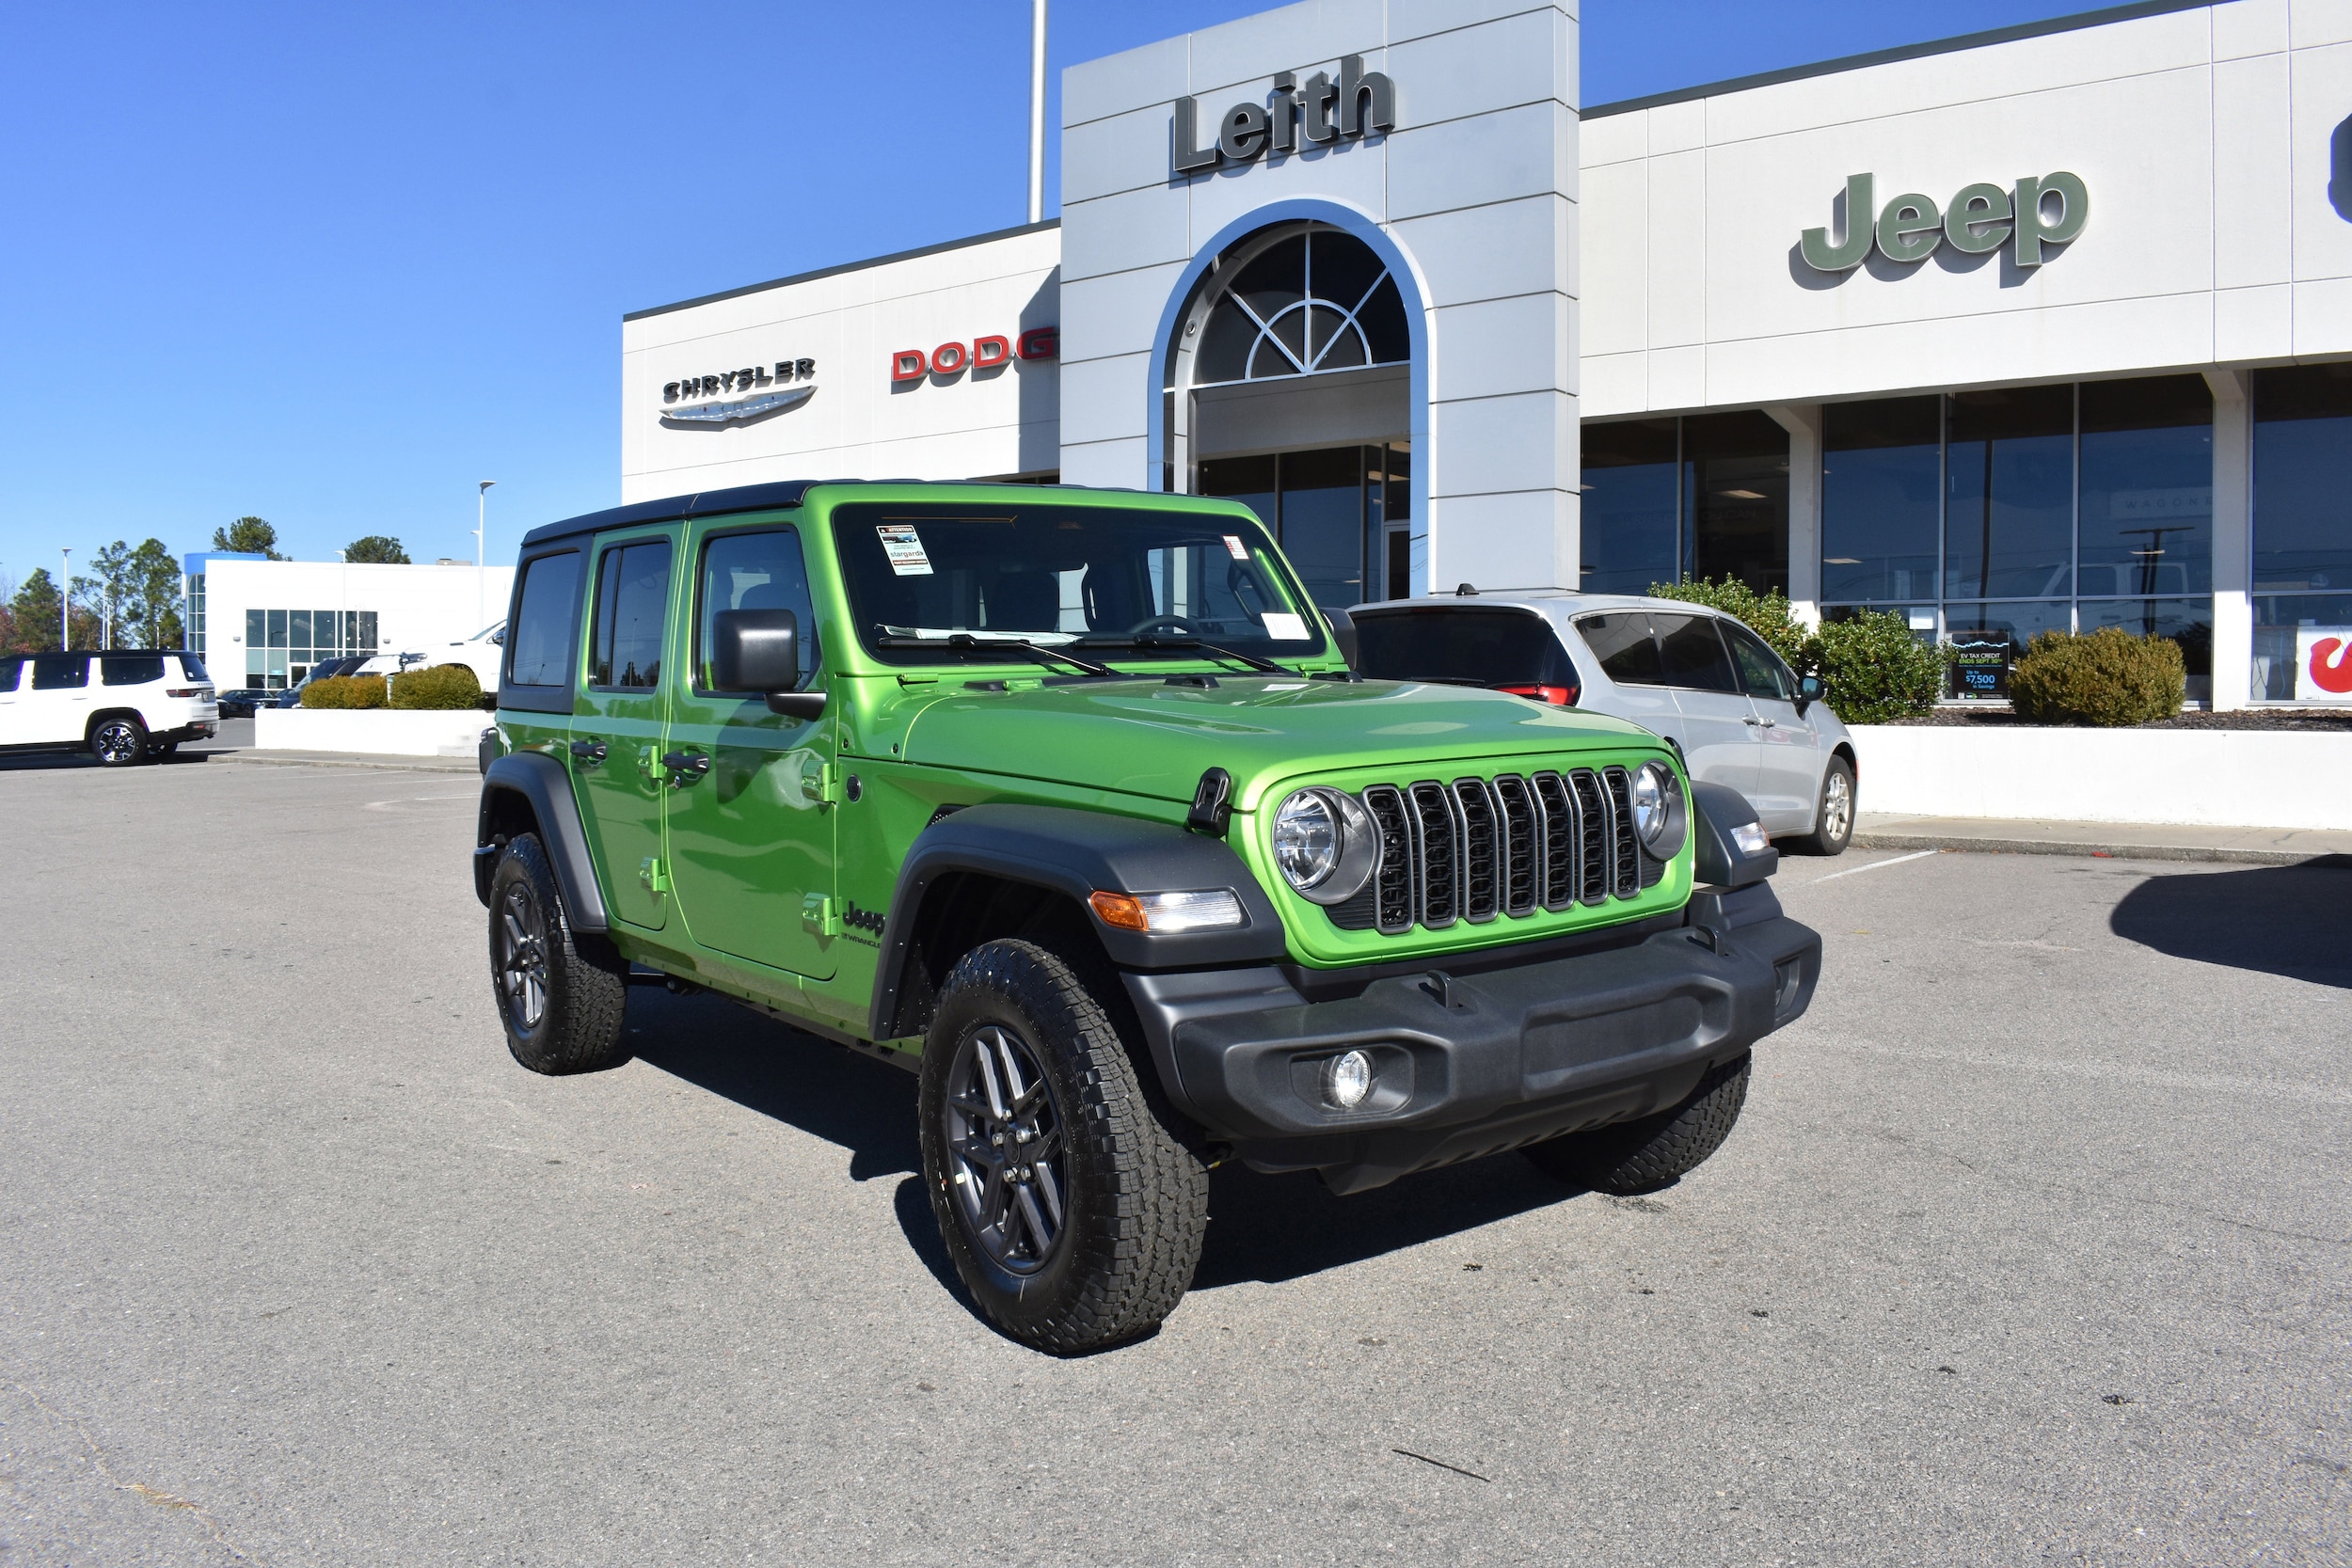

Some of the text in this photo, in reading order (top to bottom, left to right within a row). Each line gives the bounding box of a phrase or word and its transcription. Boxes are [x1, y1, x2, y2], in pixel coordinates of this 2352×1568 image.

[1173, 54, 1395, 173] Leith
[1801, 170, 2090, 272] Jeep
[892, 326, 1056, 382] DODG
[663, 357, 816, 398] CHRYSLER
[2125, 497, 2212, 509] WAGONE
[1965, 674, 1995, 685] $7,500
[843, 900, 886, 939] Jeep
[848, 934, 882, 948] WRANGLE
